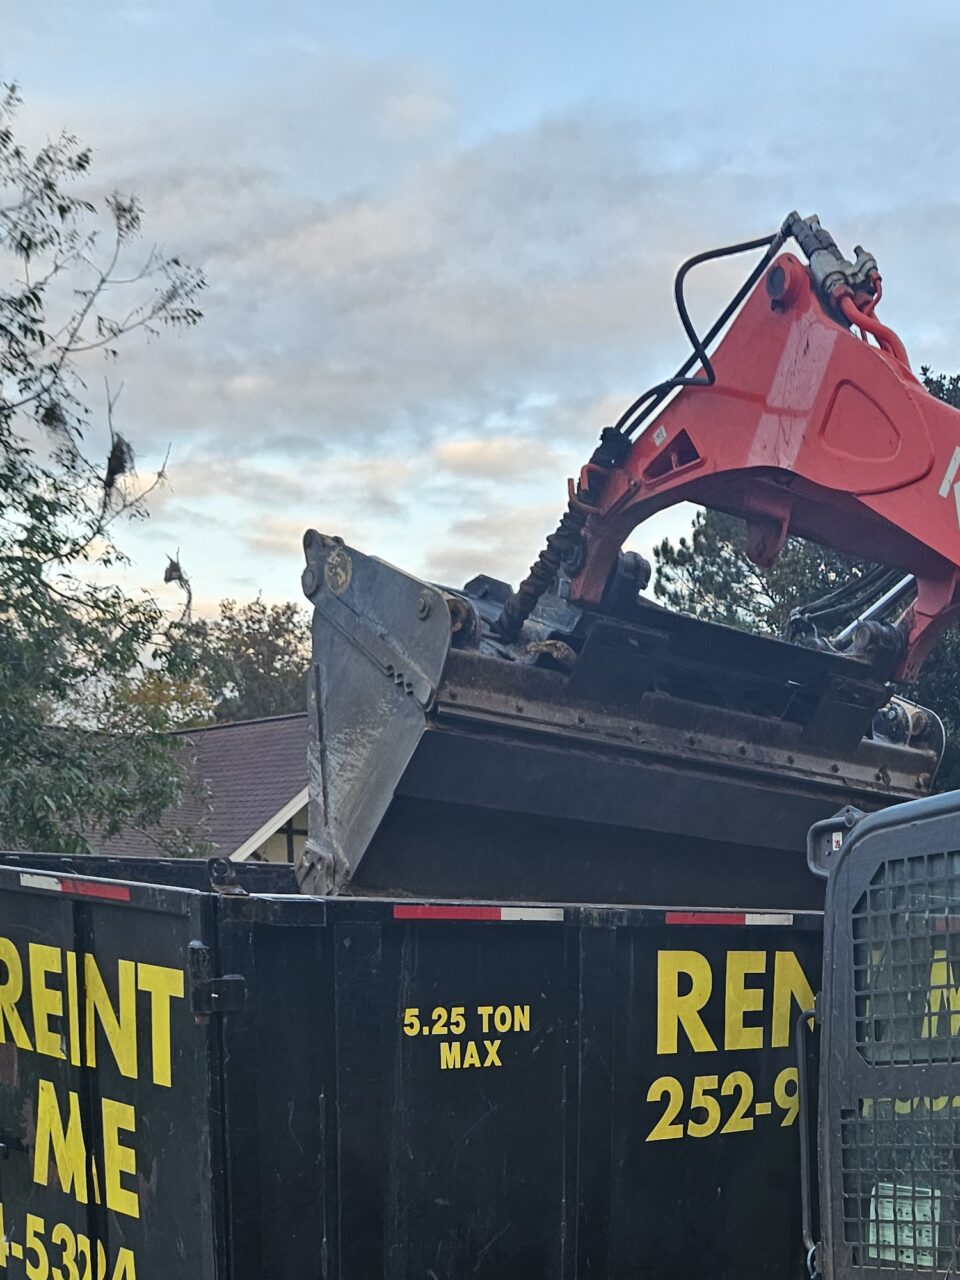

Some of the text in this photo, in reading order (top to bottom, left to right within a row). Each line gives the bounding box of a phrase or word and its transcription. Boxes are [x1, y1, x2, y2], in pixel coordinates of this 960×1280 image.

[403, 1005, 530, 1036] 5.25 TON
[440, 1040, 502, 1069] MAX
[33, 1079, 140, 1219] ME
